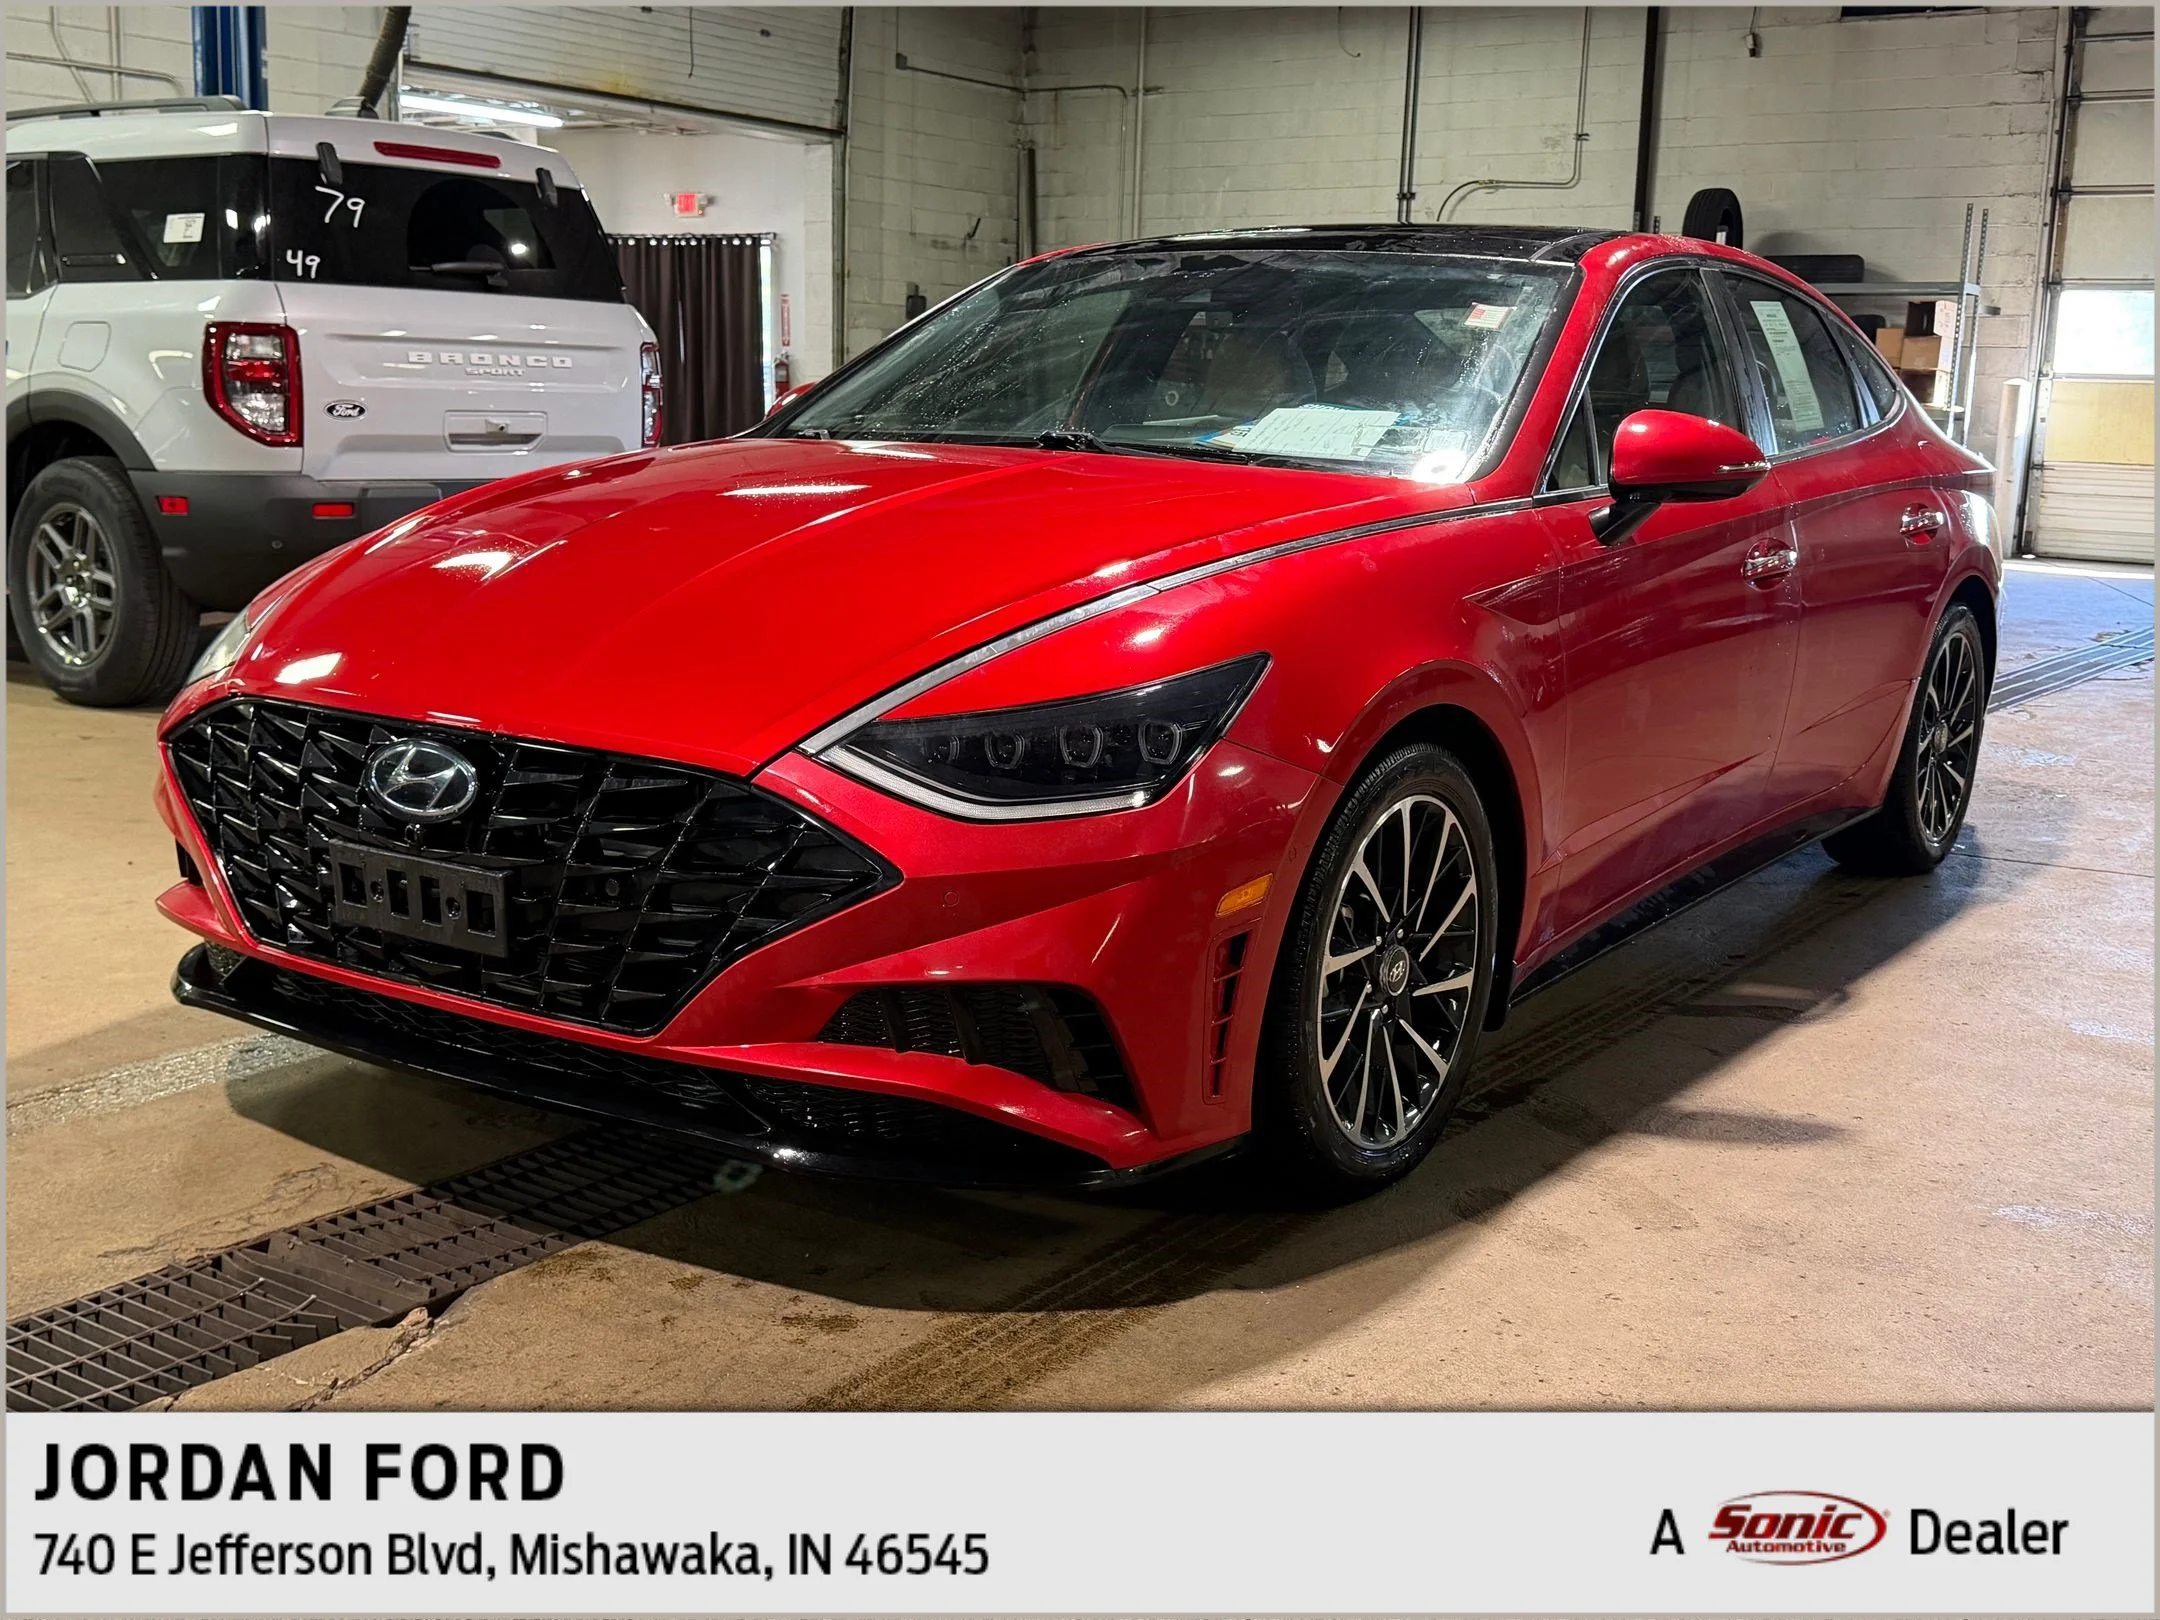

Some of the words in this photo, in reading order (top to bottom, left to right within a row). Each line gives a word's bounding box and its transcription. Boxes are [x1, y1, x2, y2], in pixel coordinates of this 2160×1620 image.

[315, 185, 366, 228] 79
[286, 249, 321, 279] 49
[408, 351, 573, 368] BRONCO
[465, 367, 526, 377] SPORT
